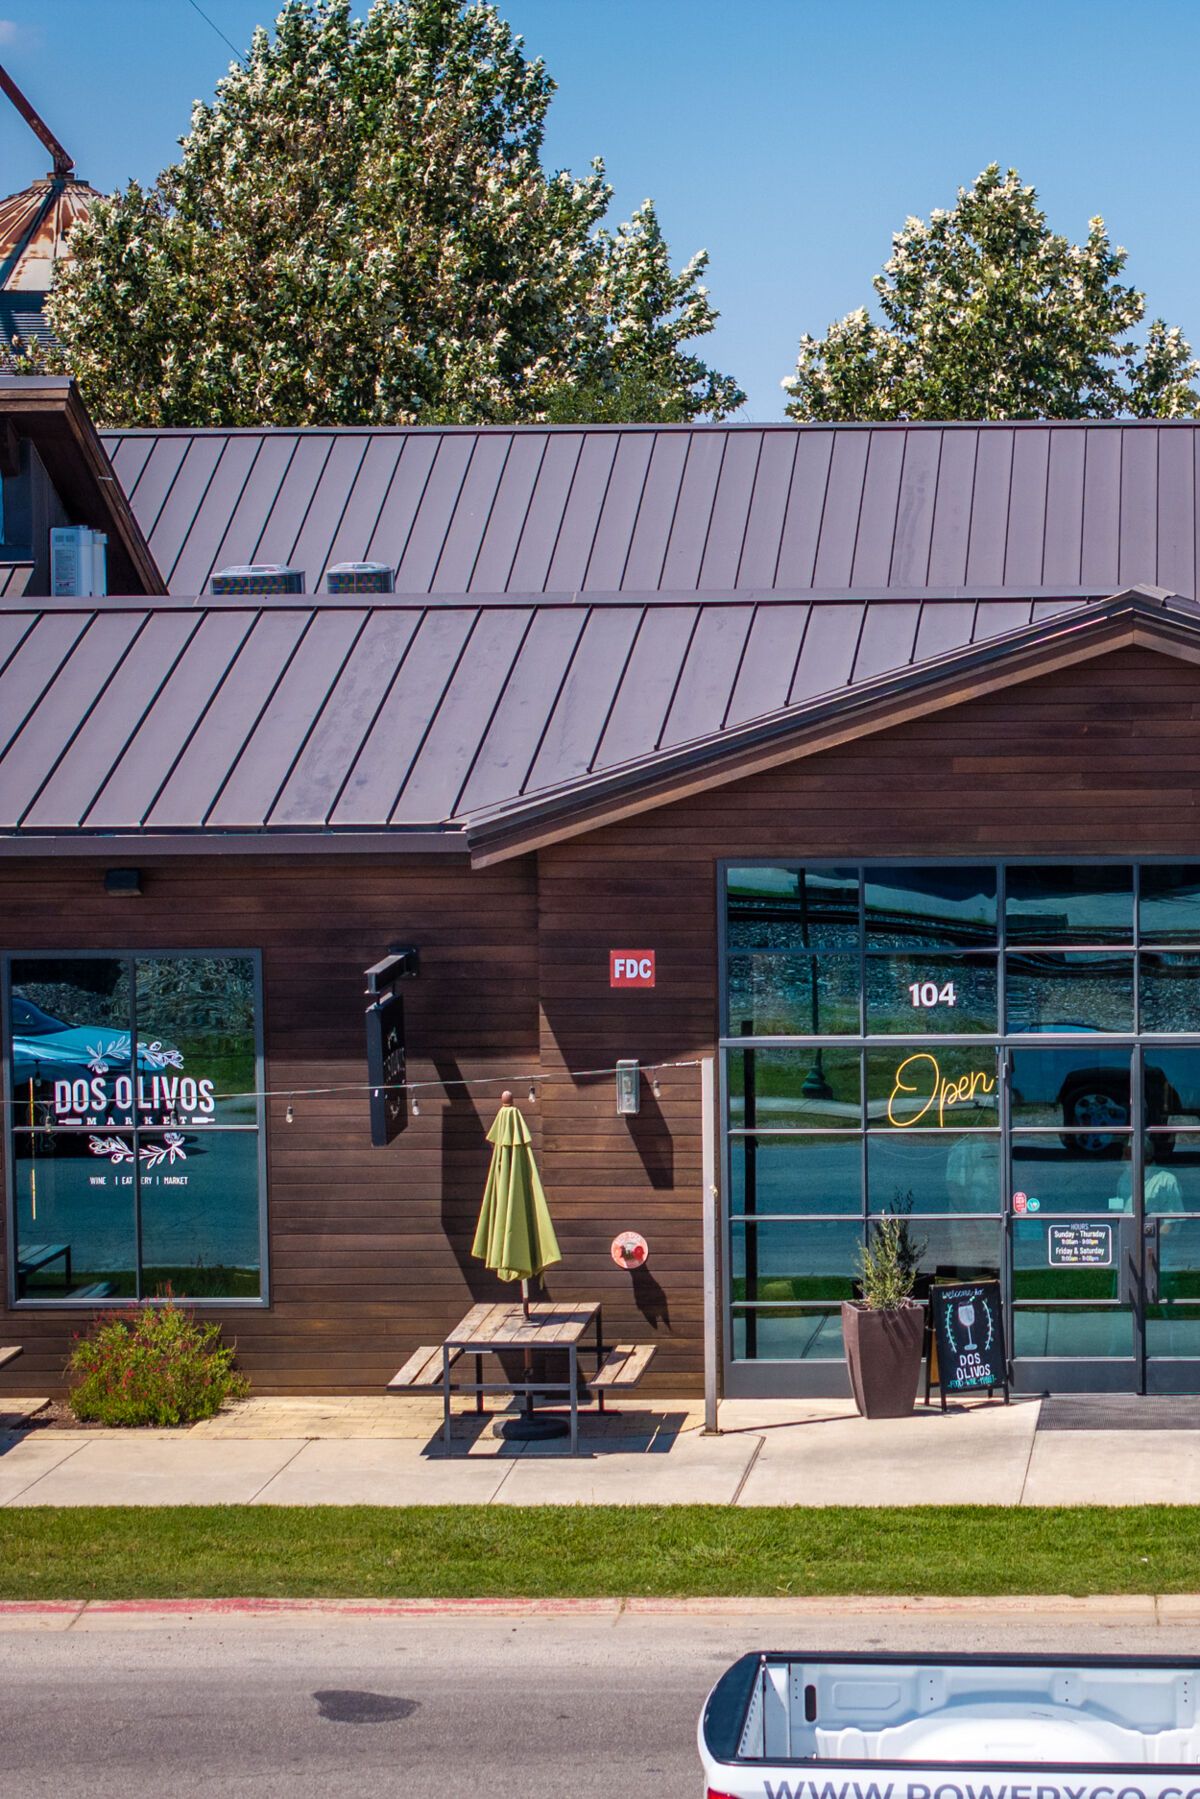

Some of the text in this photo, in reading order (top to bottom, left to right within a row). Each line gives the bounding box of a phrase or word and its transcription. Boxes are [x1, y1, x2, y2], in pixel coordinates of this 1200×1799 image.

[614, 958, 652, 979] FDC
[909, 982, 957, 1007] 104
[54, 1076, 216, 1114] DOS OLIVOS
[887, 1053, 995, 1128] Open
[86, 1116, 188, 1126] MARKET
[89, 1176, 107, 1185] WINE
[163, 1176, 189, 1185] MARKET
[1054, 1230, 1075, 1239] Sunday
[1080, 1230, 1106, 1239] Thursday
[1055, 1247, 1073, 1256] Friday
[1079, 1247, 1105, 1256] Saturday
[959, 1353, 981, 1367] DOS
[956, 1364, 991, 1381] OLIVOS
